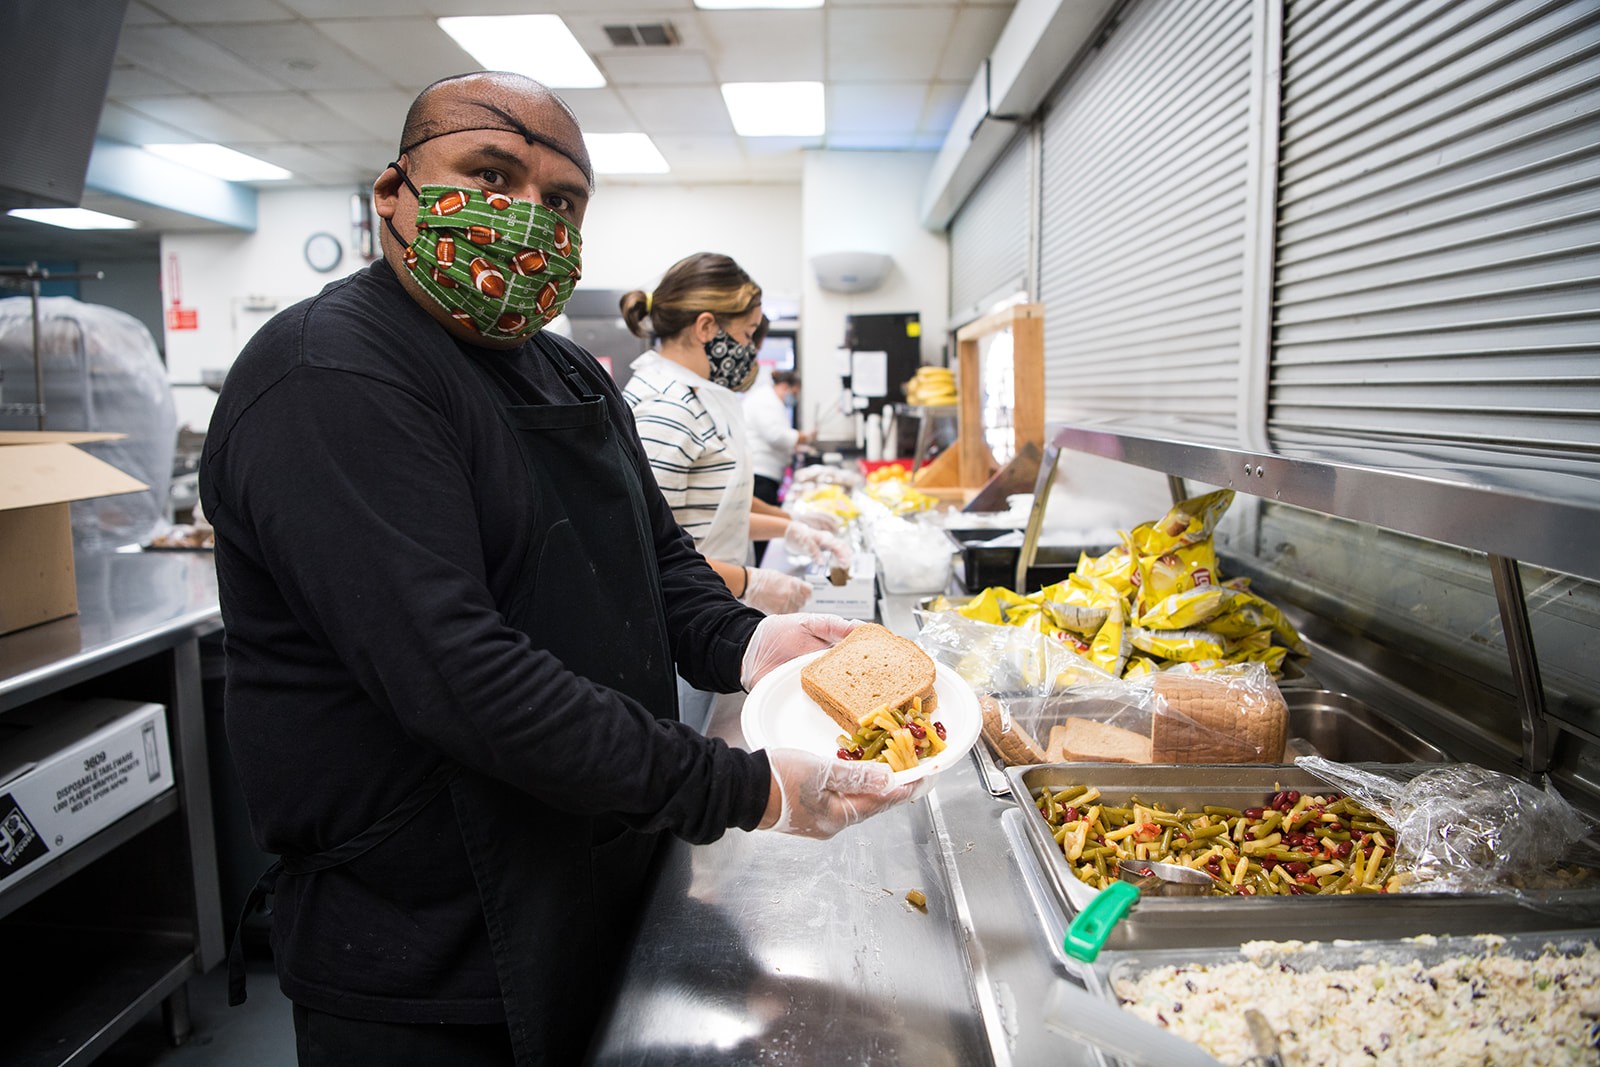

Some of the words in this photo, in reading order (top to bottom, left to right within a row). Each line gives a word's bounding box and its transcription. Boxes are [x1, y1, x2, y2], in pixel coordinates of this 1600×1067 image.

[56, 770, 98, 801] DISPOSABLE
[98, 750, 134, 776] TABLEWARE
[83, 750, 106, 771] 3609
